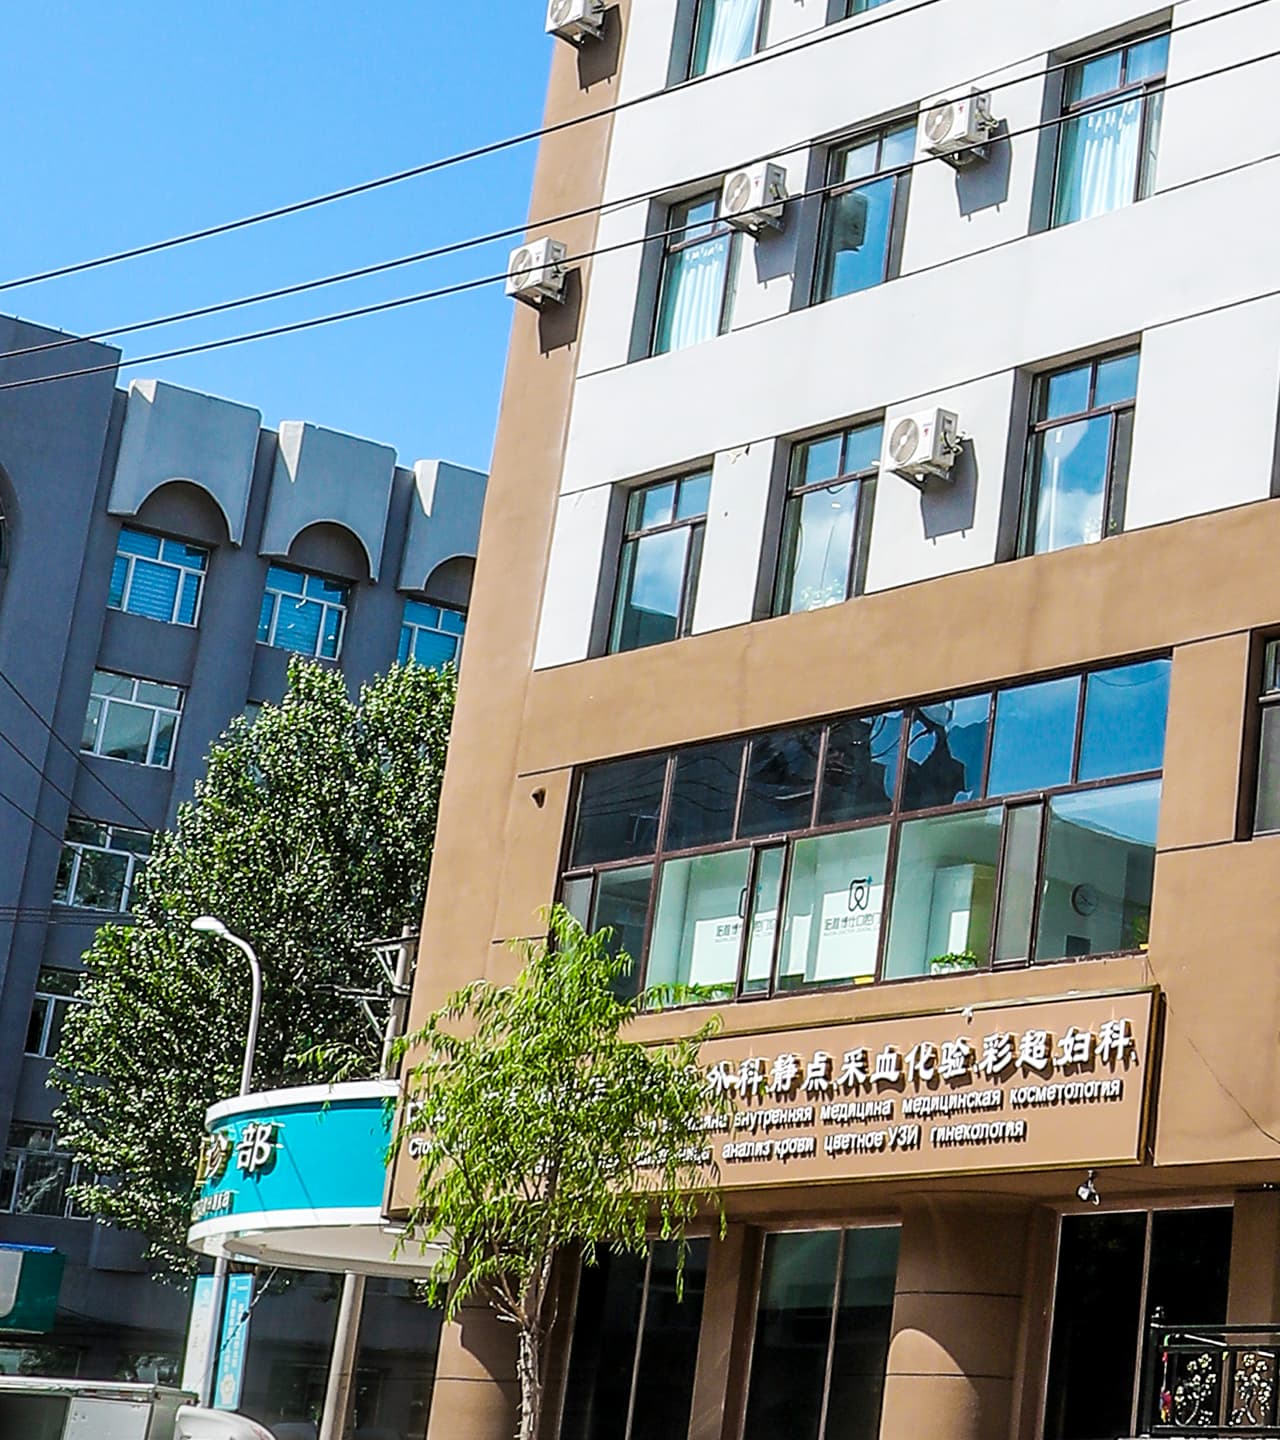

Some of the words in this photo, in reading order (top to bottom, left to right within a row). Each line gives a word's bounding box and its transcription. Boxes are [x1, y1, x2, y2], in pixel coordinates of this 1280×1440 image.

[820, 1101, 892, 1123] медицина
[902, 1089, 1001, 1115] медицинская
[1009, 1079, 1121, 1104] косметология
[722, 1140, 769, 1159] анализ
[774, 1137, 814, 1158] крови
[824, 1131, 884, 1153] цветное
[887, 1124, 919, 1146] УЗИ
[930, 1120, 1024, 1142] гинекология
